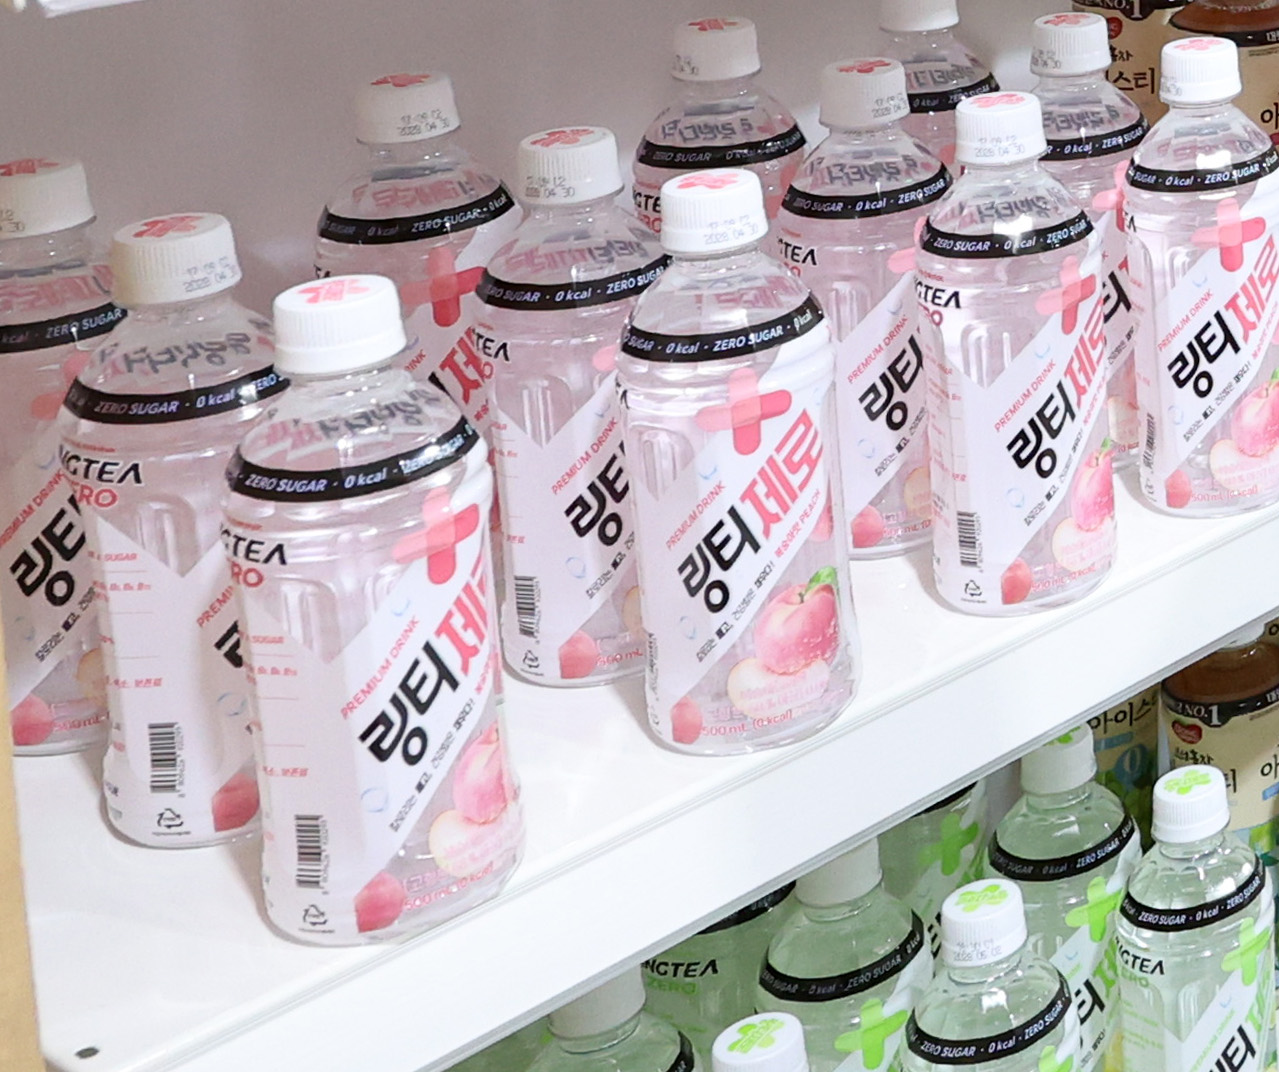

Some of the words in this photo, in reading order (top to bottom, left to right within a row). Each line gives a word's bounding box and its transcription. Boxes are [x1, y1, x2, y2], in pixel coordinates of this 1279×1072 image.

[1072, 142, 1093, 154] kcal
[1101, 136, 1124, 149] ZERO
[1122, 128, 1143, 144] SUGAR
[1134, 171, 1156, 184] SUGAR
[1173, 175, 1195, 186] kcal
[1204, 170, 1230, 184] ZERO
[1230, 162, 1260, 178] SUGAR
[811, 200, 843, 213] SUGAR
[863, 198, 887, 210] kcal
[897, 190, 924, 204] ZERO
[411, 220, 440, 233] ZERO
[445, 208, 480, 226] SUGAR
[934, 237, 954, 250] ZERO
[954, 240, 991, 252] SUGAR
[503, 290, 541, 302] SUGAR
[566, 288, 592, 301] kcal
[606, 280, 636, 294] ZERO
[46, 321, 79, 339] ZERO
[81, 309, 124, 330] SUGAR
[1158, 314, 1193, 352] PREMIUM
[1190, 292, 1214, 319] DRINK
[675, 341, 700, 354] kcal
[713, 335, 747, 352] ZERO
[747, 326, 784, 346] SUGAR
[847, 342, 884, 384] PREMIUM
[882, 313, 909, 348] DRINK
[128, 400, 180, 414] SUGAR
[207, 389, 237, 407] kcal
[994, 391, 1033, 433] PREMIUM
[1032, 359, 1057, 393] DRINK
[551, 440, 593, 496] PREMIUM
[590, 417, 619, 454] DRINK
[245, 473, 276, 491] ZERO
[276, 478, 328, 493] SUGAR
[358, 468, 387, 487] kcal
[666, 508, 699, 551] PREMIUM
[696, 481, 727, 517] DRINK
[800, 489, 822, 523] PEACH
[339, 656, 393, 719] PREMIUM
[390, 615, 420, 659] DRINK
[359, 560, 492, 768] 링티제
[1184, 703, 1221, 726] NO.1
[1076, 852, 1097, 869] ZERO
[1096, 838, 1120, 860] SUGAR
[1138, 911, 1160, 925] ZERO
[1159, 914, 1187, 926] SUGAR
[1203, 906, 1220, 919] kcal
[1226, 894, 1244, 911] ZERO
[1243, 876, 1262, 898] SUGAR
[642, 959, 719, 979] NGTEA
[845, 970, 873, 992] ZERO
[872, 954, 903, 977] SUGAR
[921, 1043, 941, 1057] ZERO
[941, 1044, 976, 1057] SUGAR
[996, 1036, 1016, 1051] kcal
[1024, 1019, 1045, 1040] ZERO
[1044, 1001, 1064, 1026] SUGAR
